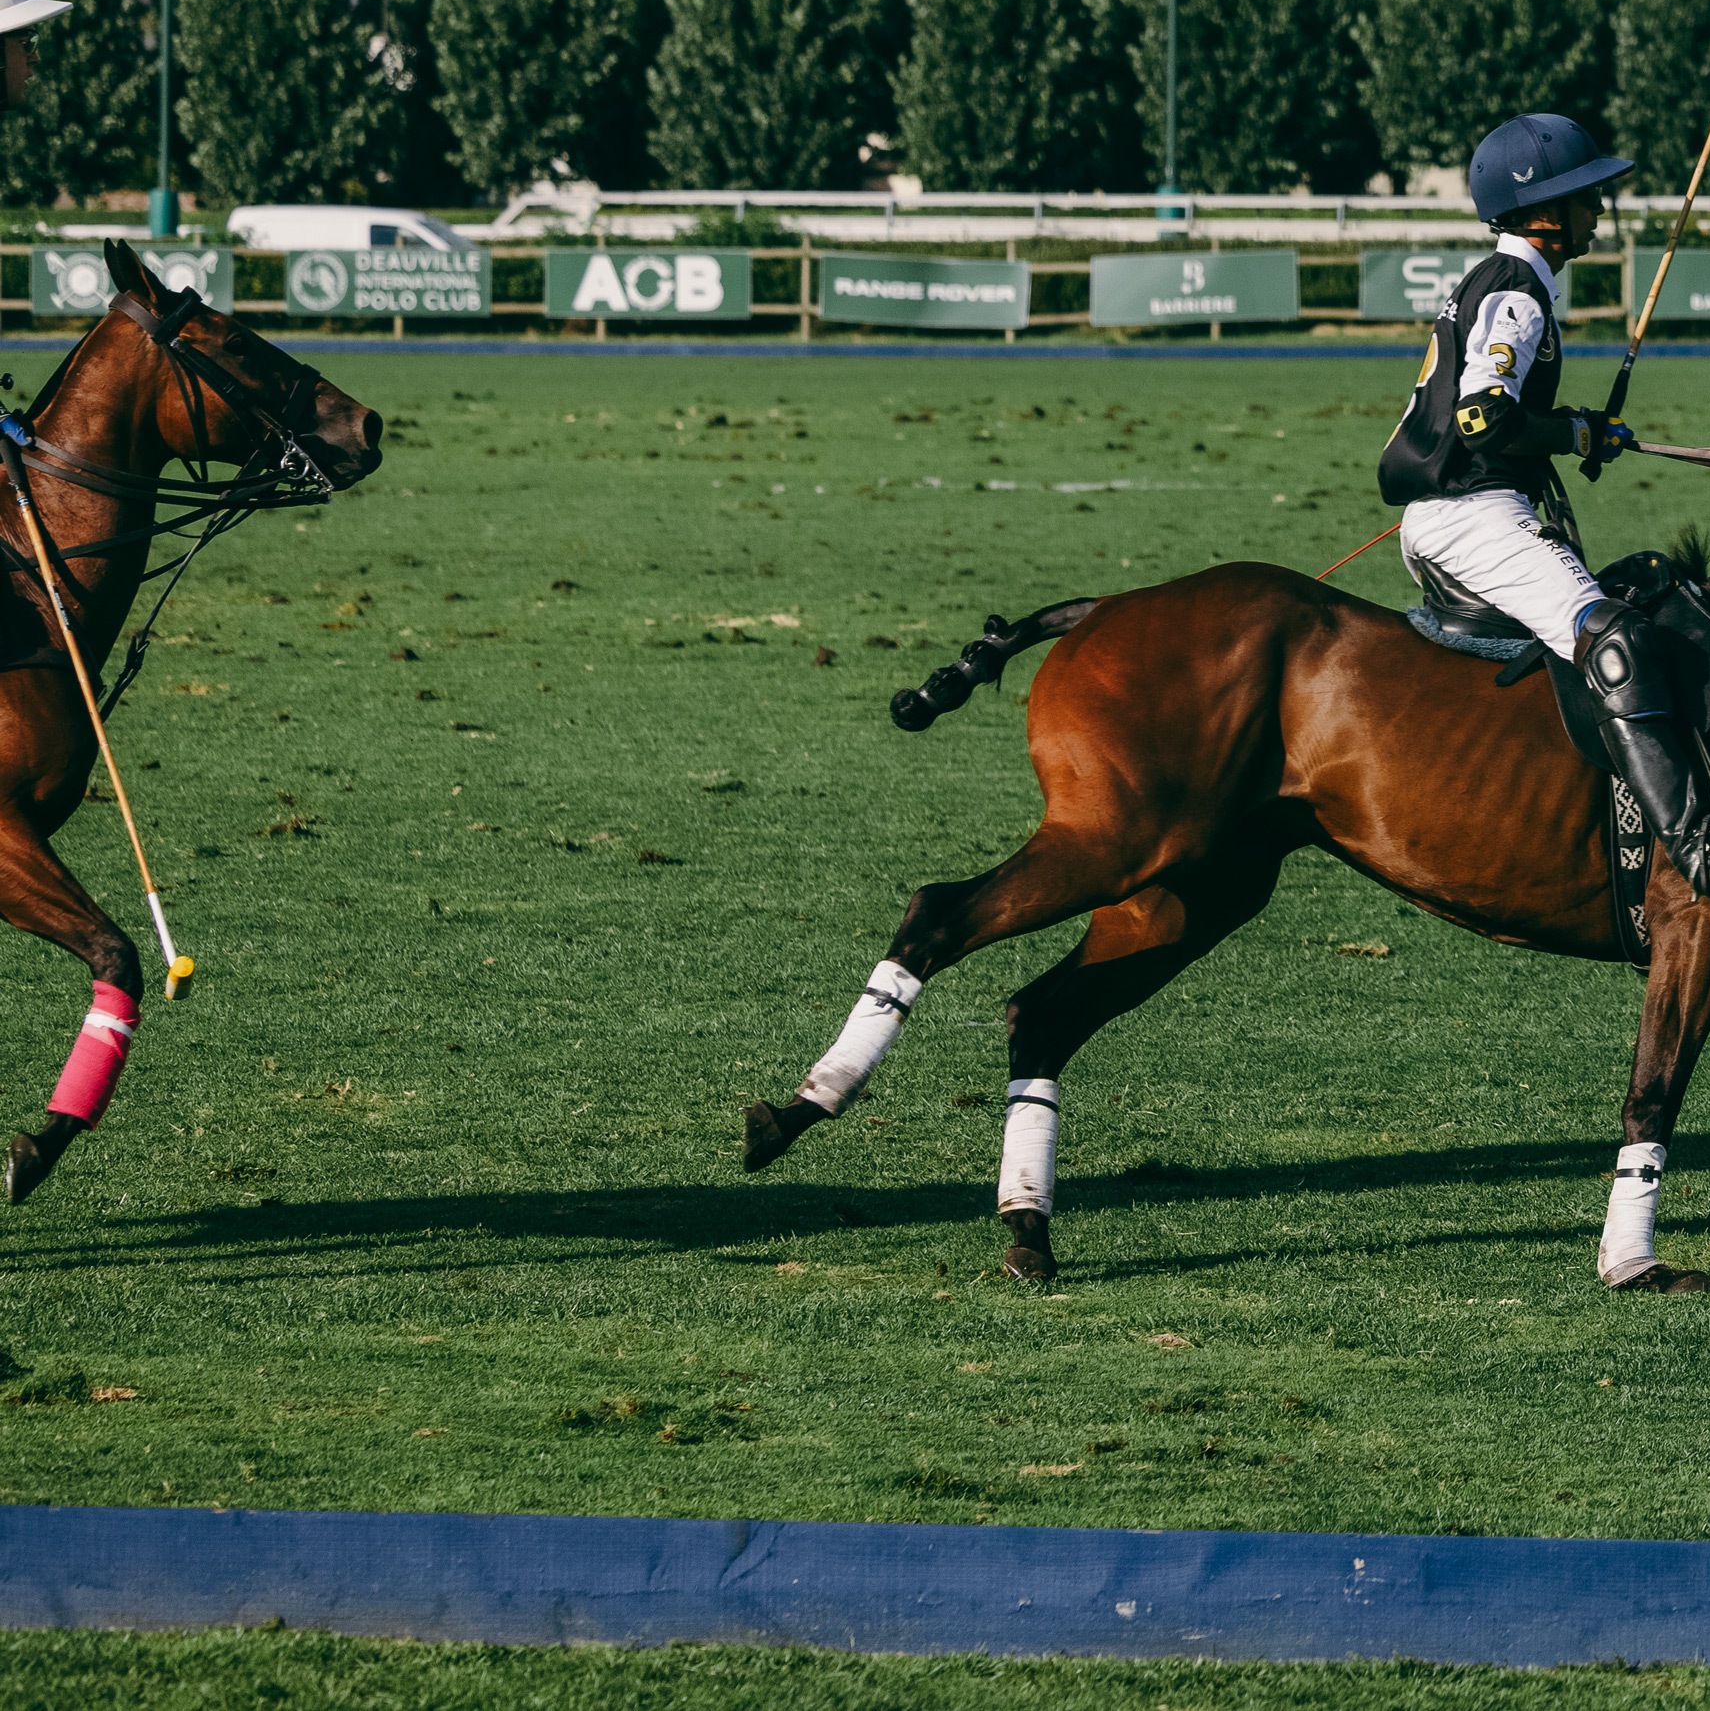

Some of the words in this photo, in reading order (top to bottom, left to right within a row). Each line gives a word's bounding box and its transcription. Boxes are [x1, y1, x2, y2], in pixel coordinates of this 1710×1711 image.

[355, 251, 481, 272] DEAUVILLE
[355, 272, 481, 290] INTERNATIONAL
[834, 277, 926, 300] RANGE
[927, 282, 1016, 303] ROVER
[355, 290, 418, 311] POLO
[423, 290, 481, 311] CLUB
[1517, 520, 1591, 585] BARIERE
